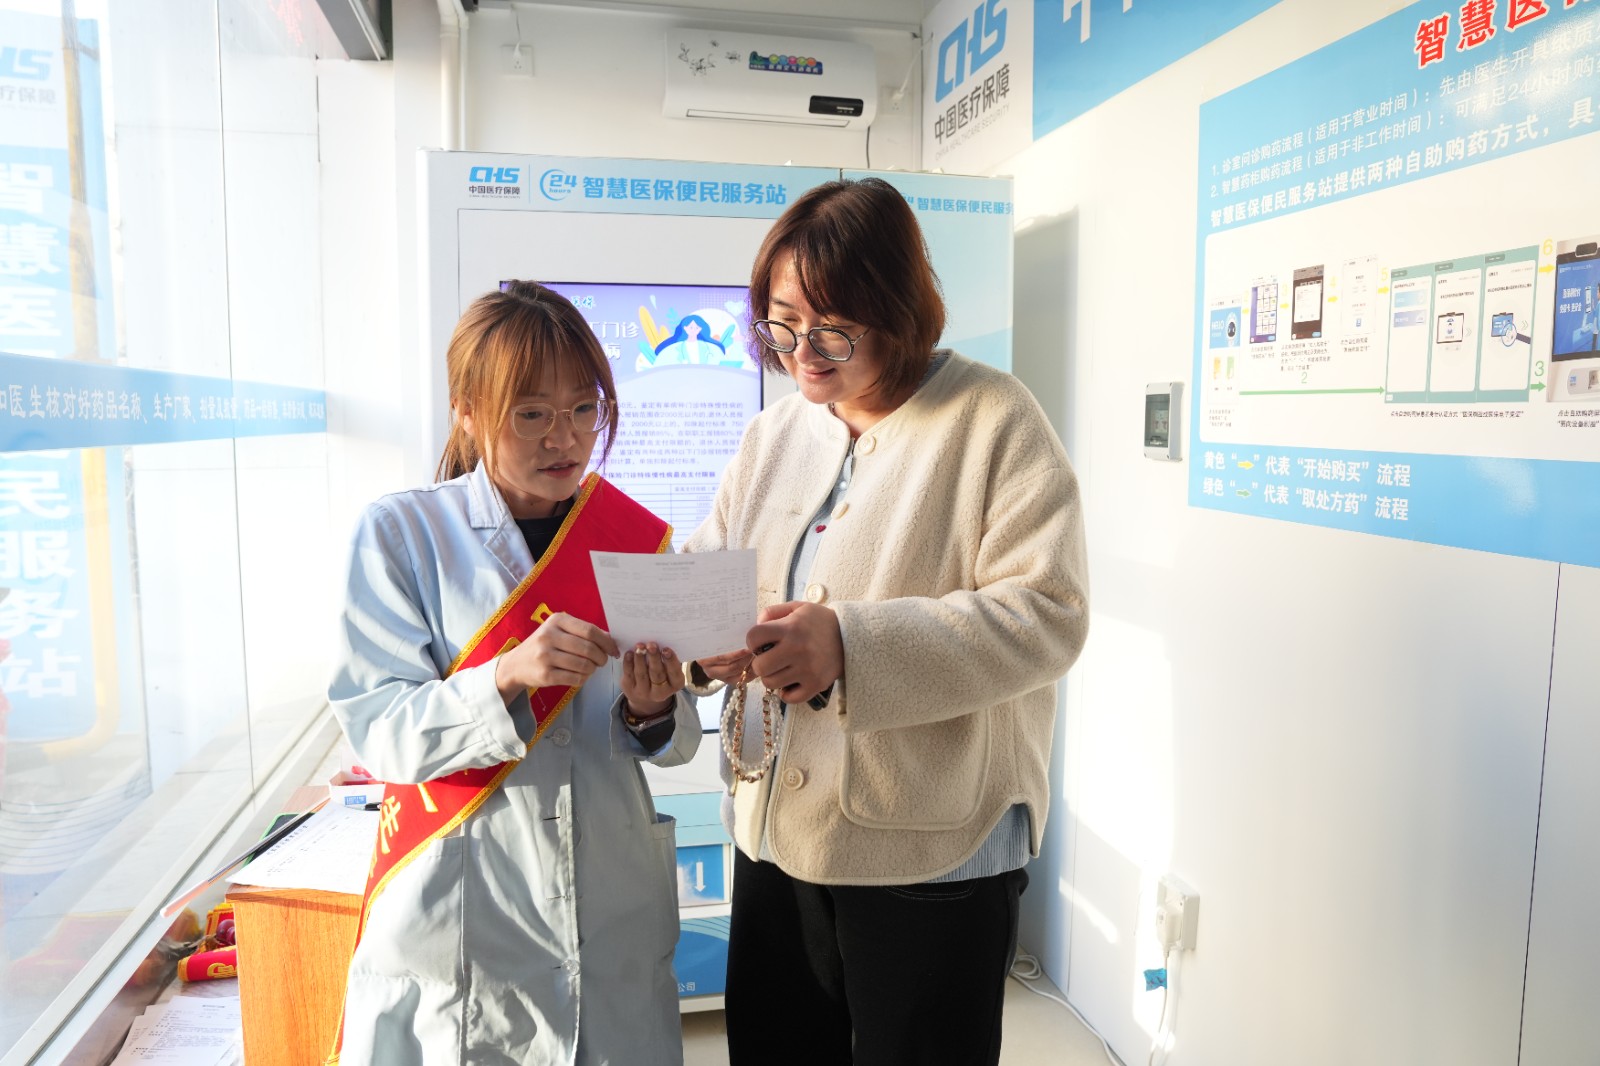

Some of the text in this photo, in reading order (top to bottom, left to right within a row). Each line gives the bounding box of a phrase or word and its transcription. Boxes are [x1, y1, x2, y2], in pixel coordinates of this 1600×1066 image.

[934, 63, 1010, 144] 中国医疗保障
[1222, 52, 1600, 196] 智慧药柜购药流程（适用于非工作时间）：可满足24小时购
[1210, 97, 1600, 228] 智慧医保便民服务站提供两种自助购药方式，具
[549, 174, 577, 188] 24
[468, 184, 521, 197] 中国医疗保障
[583, 176, 787, 205] 智慧医保便民服务站
[1543, 238, 1553, 255] 6
[1381, 267, 1388, 281] 5
[1534, 360, 1545, 377] 3
[1301, 371, 1308, 384] 2
[606, 471, 716, 479] 保险门诊特殊慢性病最高支付限额
